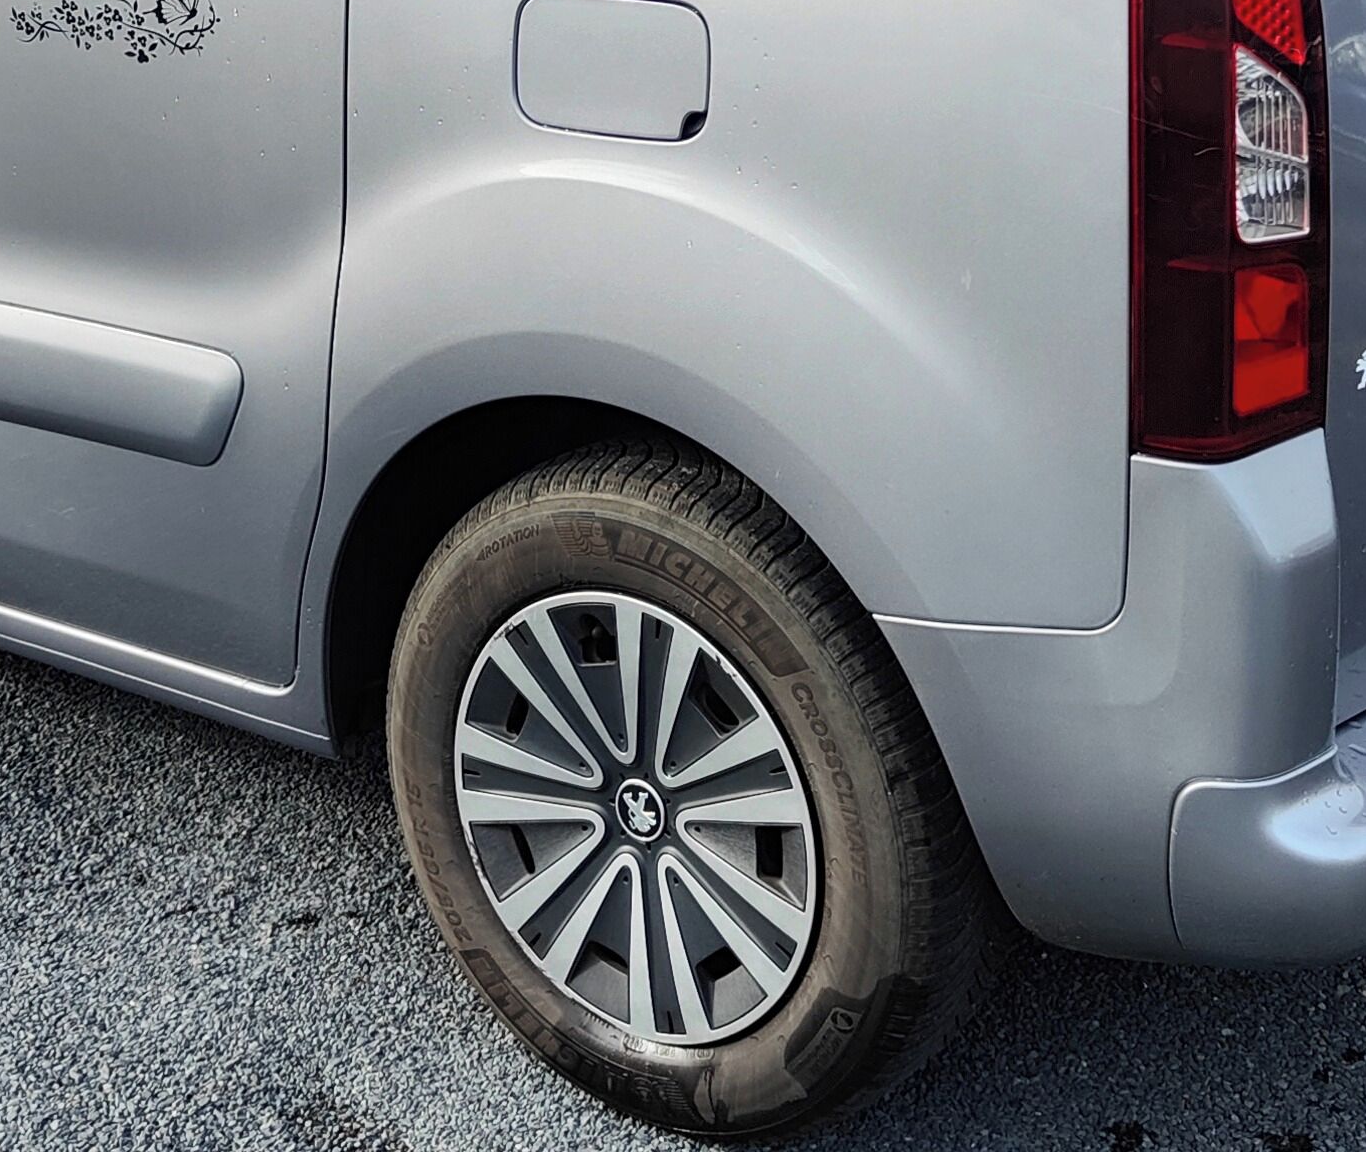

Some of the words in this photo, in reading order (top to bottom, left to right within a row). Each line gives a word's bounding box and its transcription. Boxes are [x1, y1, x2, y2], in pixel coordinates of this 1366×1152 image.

[484, 524, 540, 559] ROTATION
[616, 529, 799, 674] MICHELIN
[791, 682, 868, 888] CROSSCLIMATE
